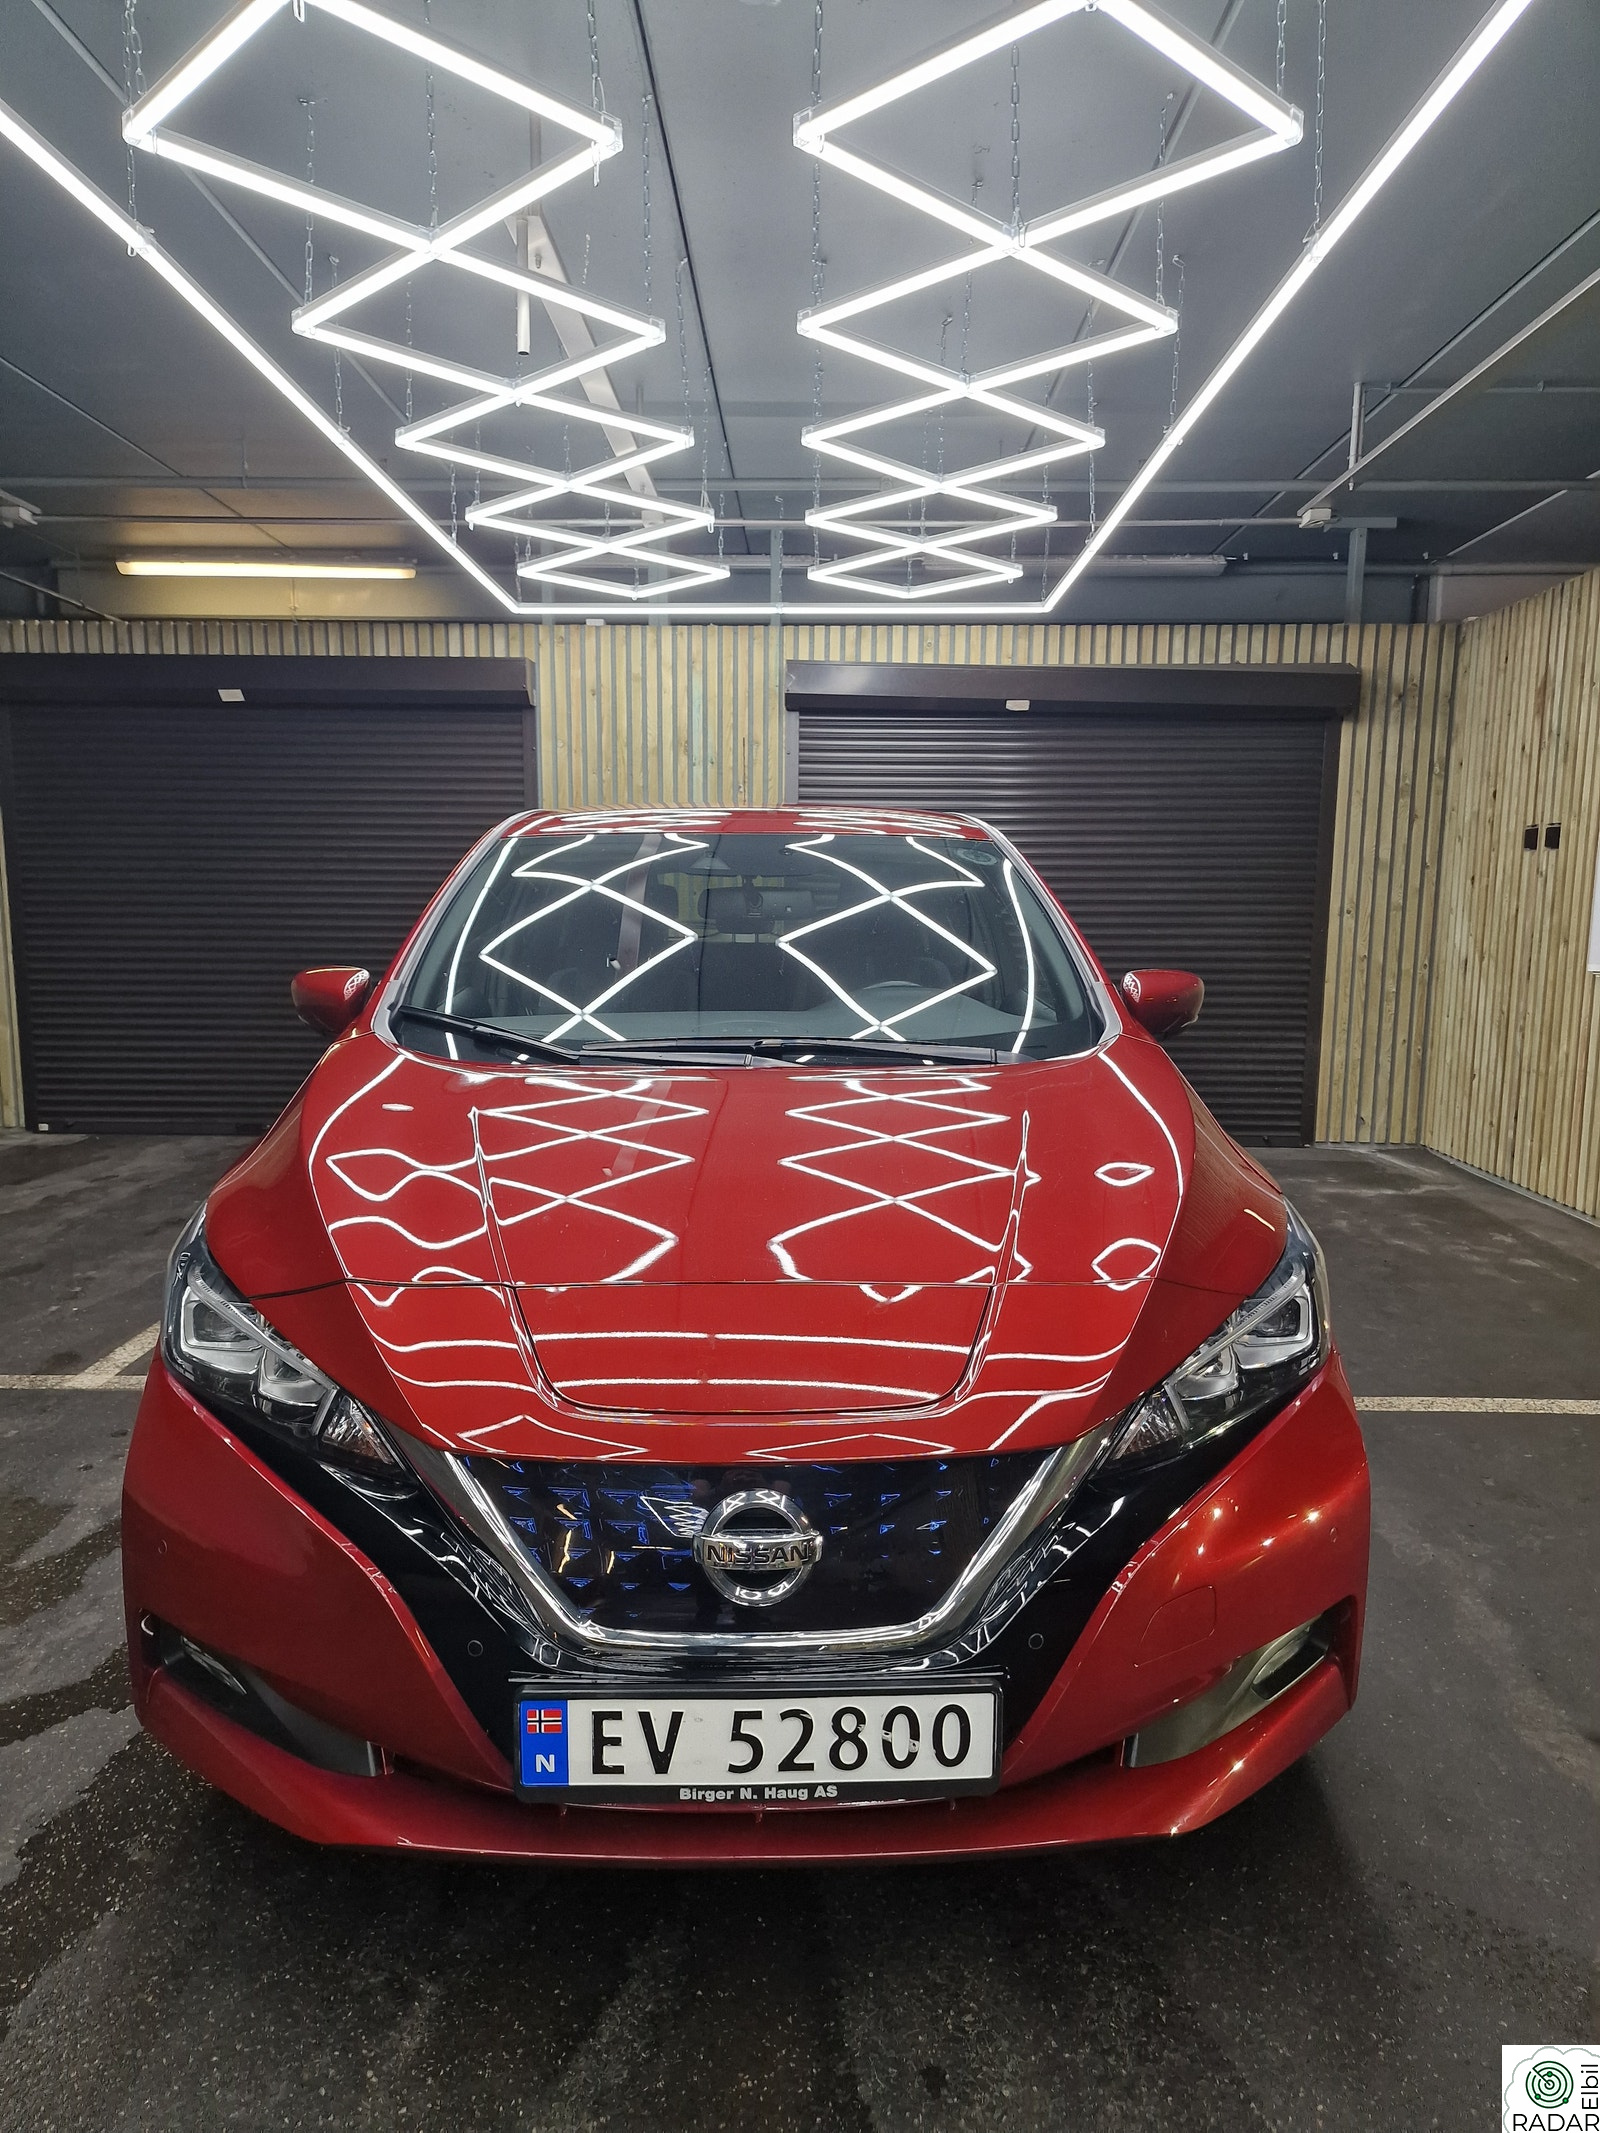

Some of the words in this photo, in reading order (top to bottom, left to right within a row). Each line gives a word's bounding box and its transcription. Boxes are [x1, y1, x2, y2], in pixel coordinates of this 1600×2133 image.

[707, 1542, 809, 1564] NISSAN
[590, 1710, 685, 1776] EV
[727, 1704, 972, 1774] 52800
[535, 1754, 556, 1774] N
[679, 1787, 734, 1802] Birger
[740, 1787, 758, 1800] N.
[764, 1787, 809, 1800] Haug
[814, 1785, 838, 1798] AS
